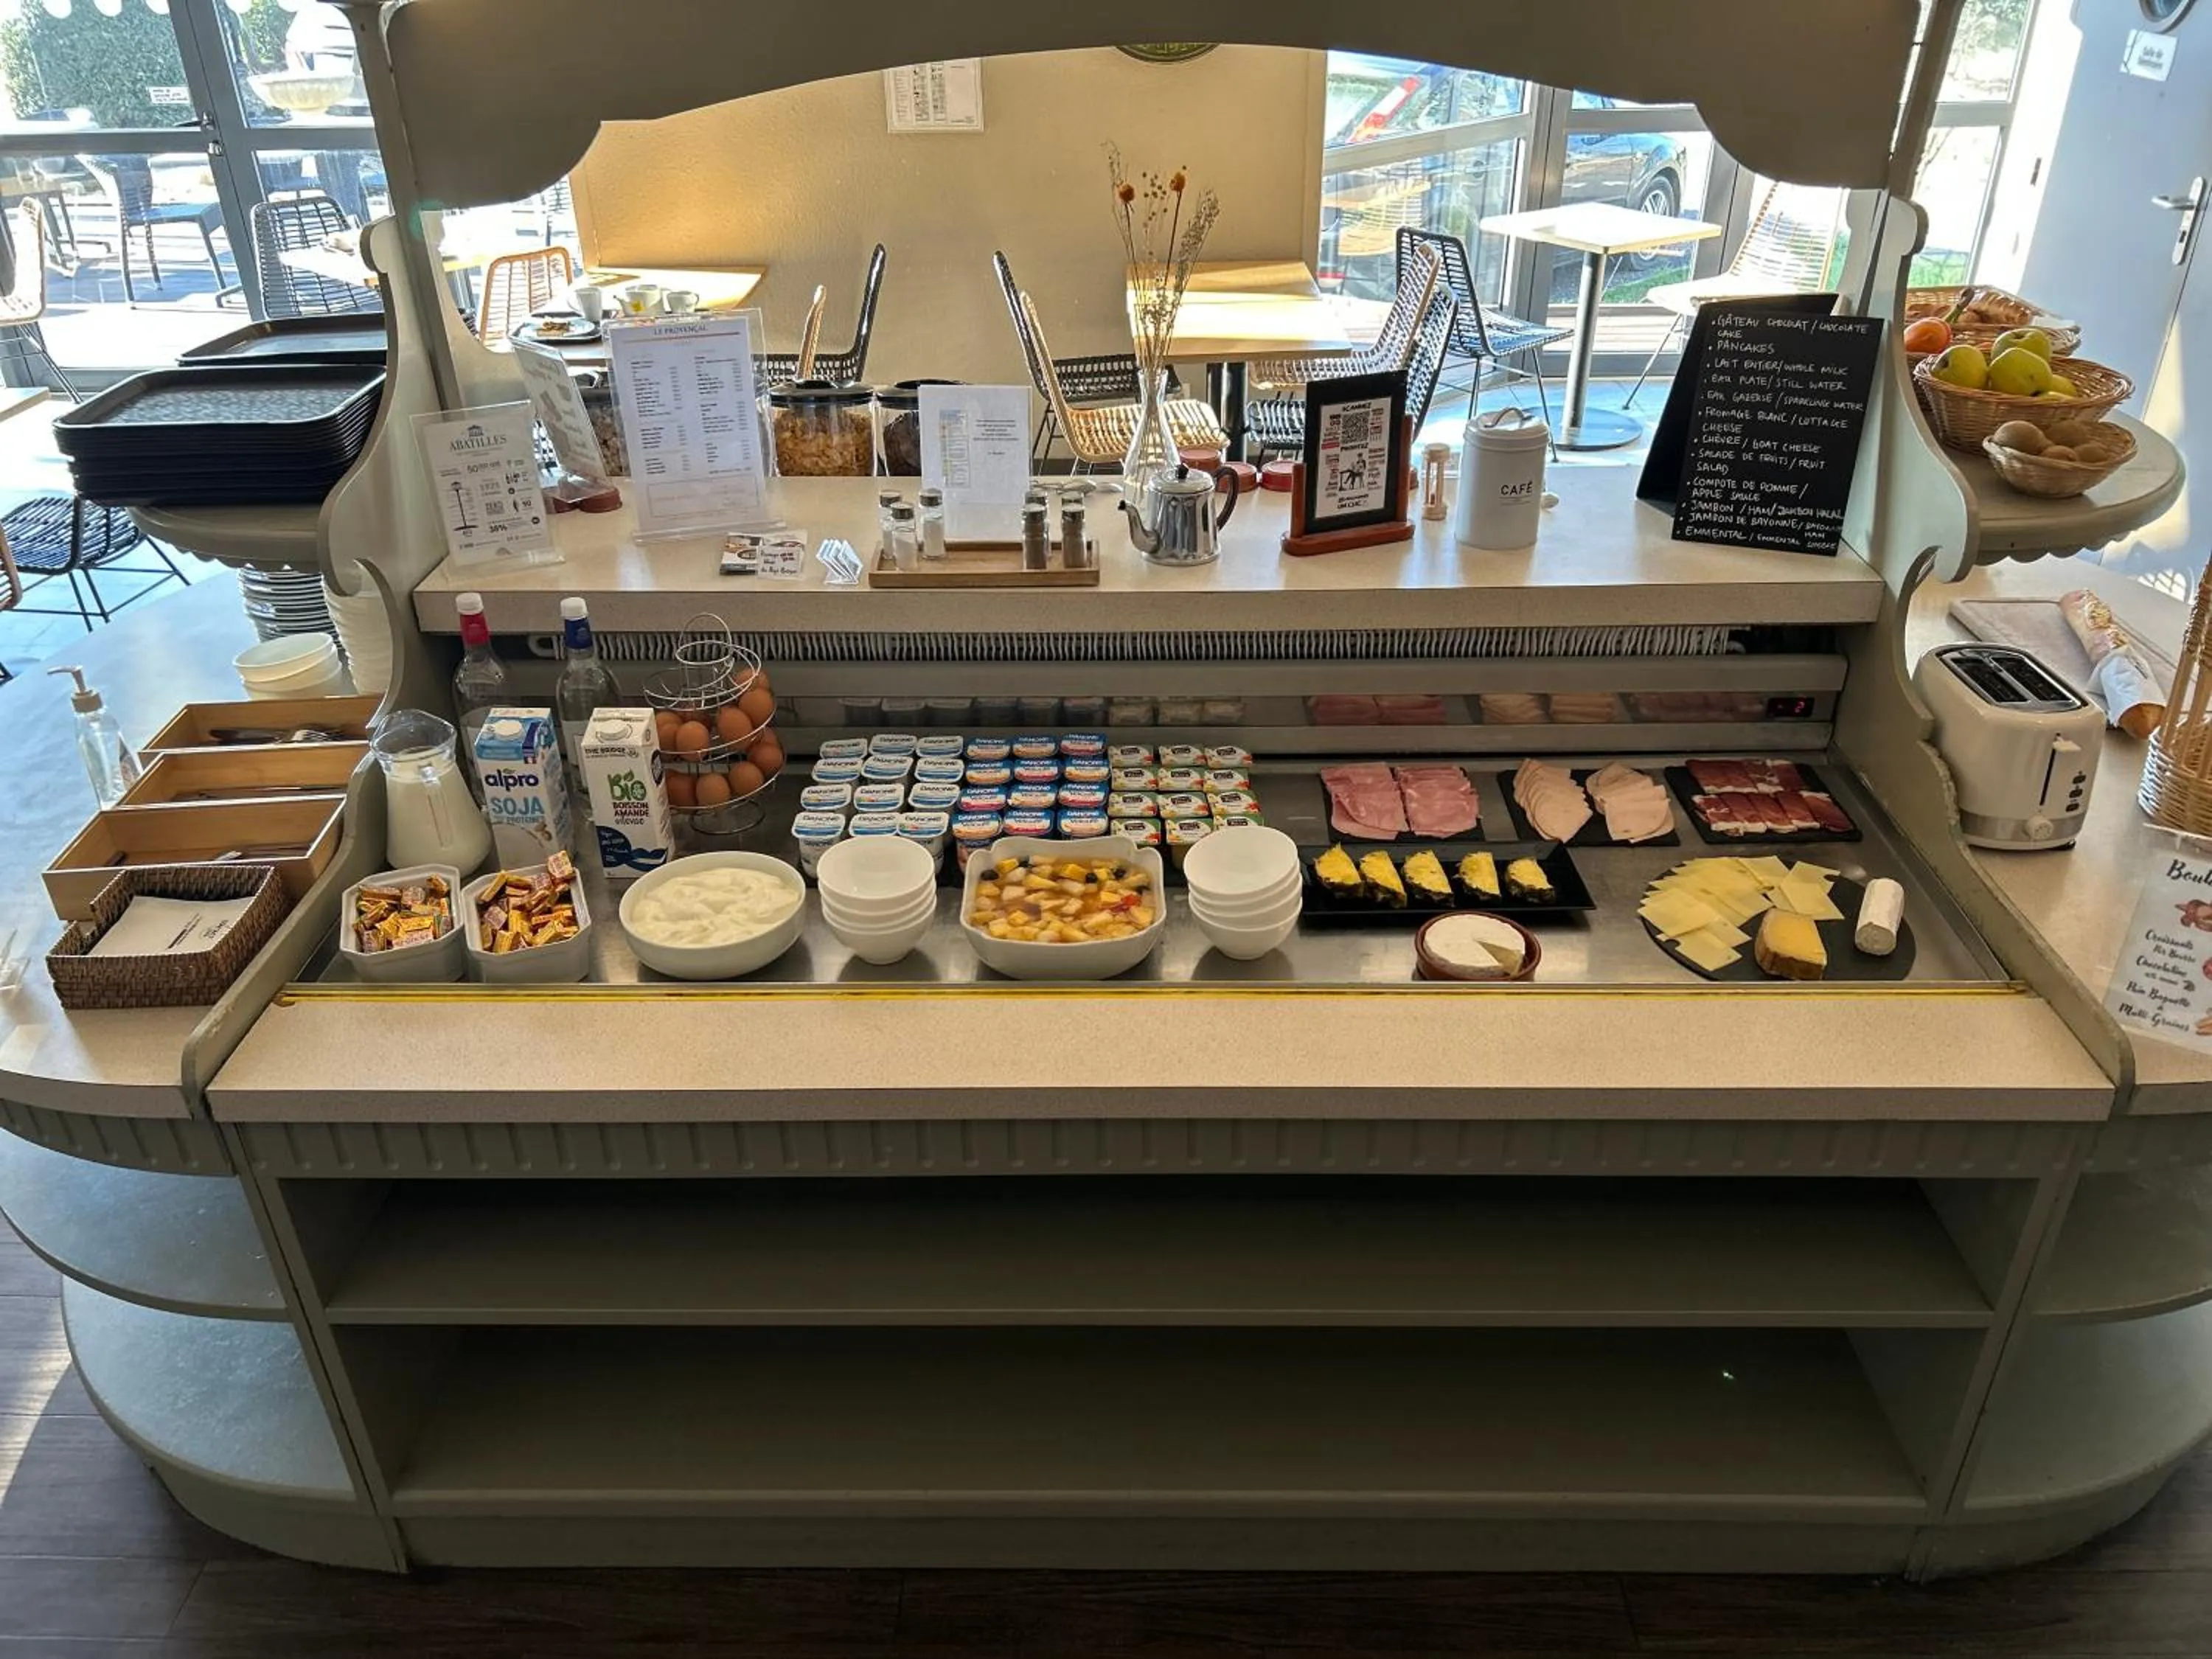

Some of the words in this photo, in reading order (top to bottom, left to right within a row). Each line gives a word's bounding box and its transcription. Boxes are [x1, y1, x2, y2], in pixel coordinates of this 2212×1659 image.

[1717, 314, 1759, 327] GÂTEAU
[1717, 340, 1775, 354] PANCAKES
[1809, 381, 1848, 391] WATER
[1742, 451, 1755, 461] DE
[1500, 481, 1533, 496] CAFÉ
[1691, 487, 1724, 499] APPLE
[484, 768, 539, 793] alpro
[490, 796, 545, 815] SOJA
[2166, 859, 2212, 886] Boul
